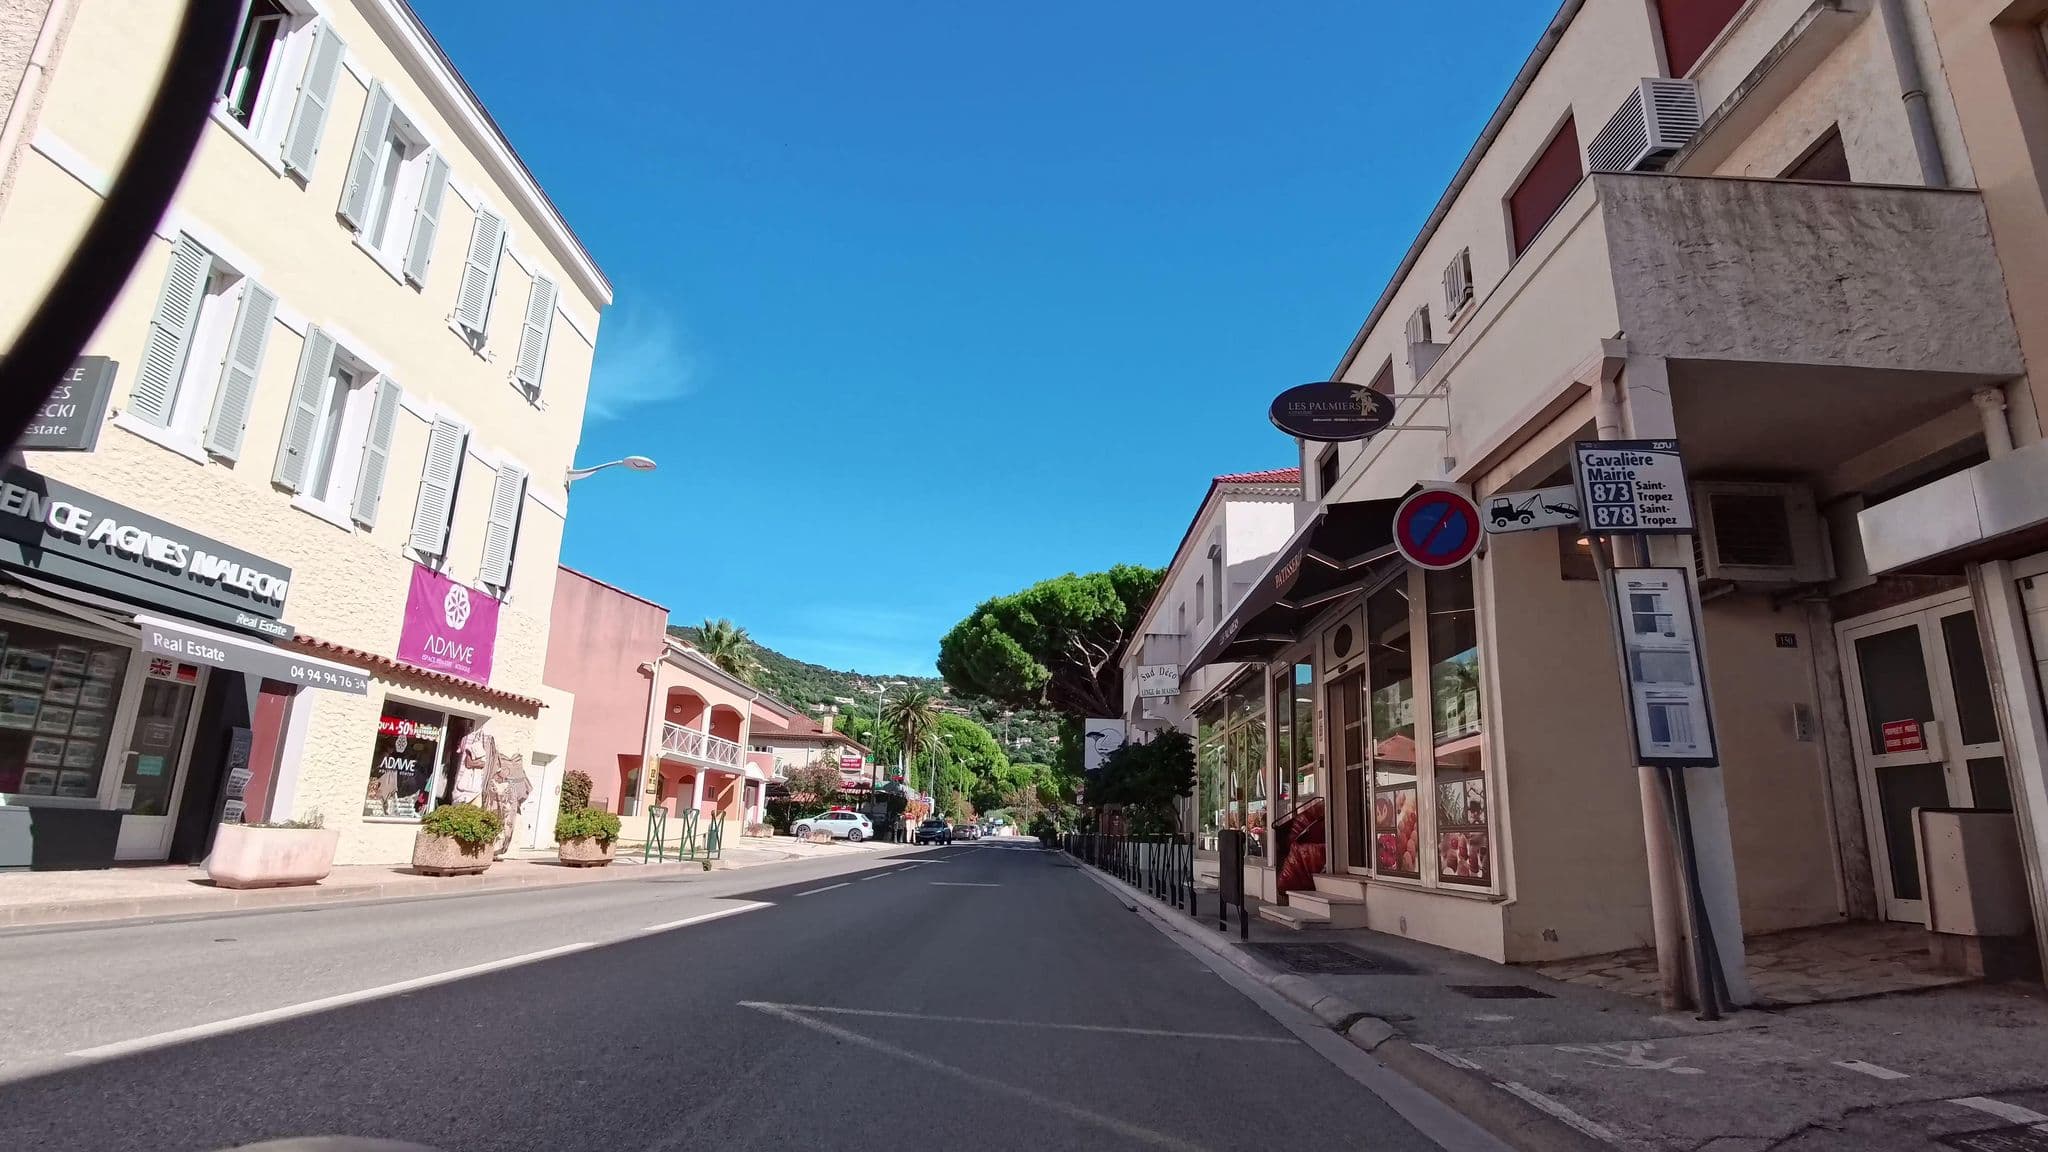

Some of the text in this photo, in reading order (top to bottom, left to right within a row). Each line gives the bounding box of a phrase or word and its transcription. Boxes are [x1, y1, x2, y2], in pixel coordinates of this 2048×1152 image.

[1288, 402, 1361, 411] LES PALMIERS
[1585, 452, 1653, 466] Cavalière
[1587, 467, 1636, 481] Mairie
[1593, 483, 1631, 502] 873
[1635, 481, 1666, 490] Saint-
[1637, 492, 1673, 503] Tropez
[1596, 506, 1635, 525] 878
[1639, 504, 1670, 513] Saint-
[1641, 515, 1677, 527] Tropez
[88, 518, 189, 569] AGNES
[188, 550, 288, 602] MALECKI
[236, 613, 287, 636] Real Estate
[153, 632, 225, 662] Real Estate
[423, 634, 475, 664] ADAWE
[290, 665, 304, 679] 04
[307, 669, 321, 682] 94
[323, 672, 338, 685] 94
[339, 675, 352, 688] 76
[380, 756, 417, 772] ADAWE
